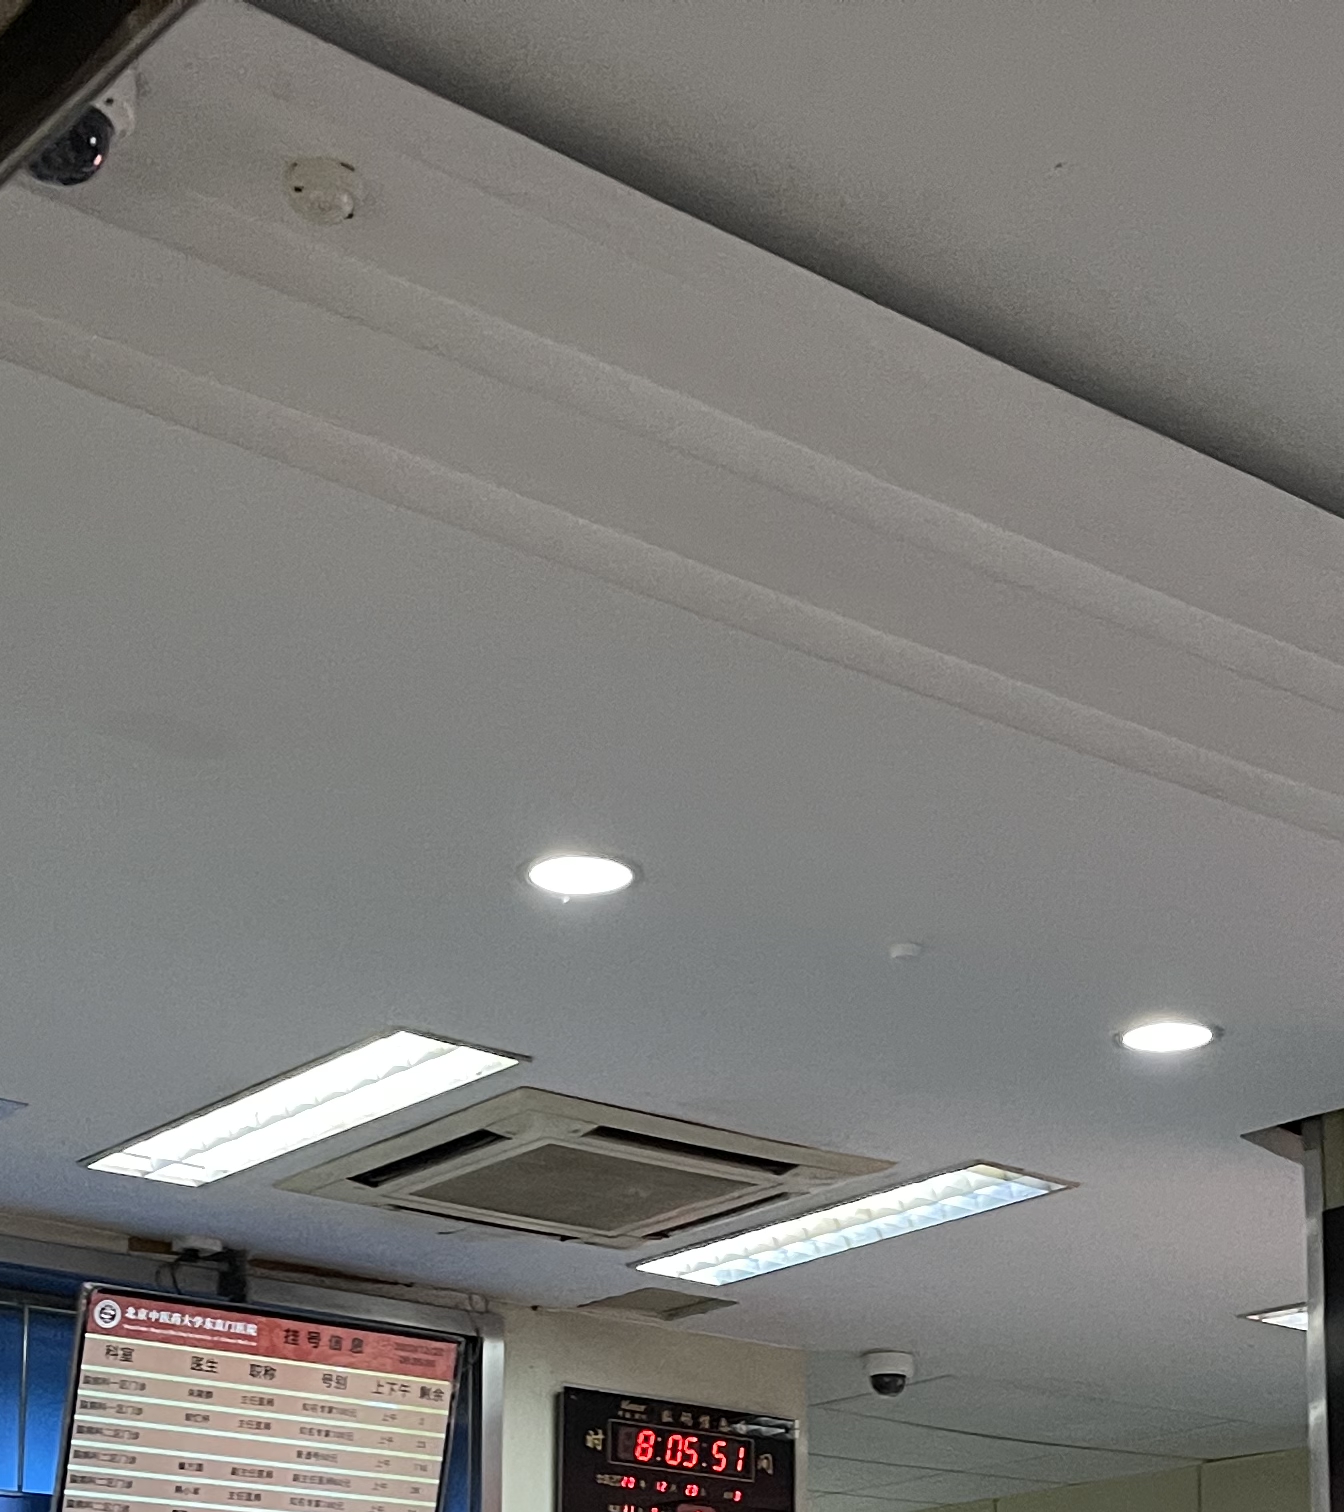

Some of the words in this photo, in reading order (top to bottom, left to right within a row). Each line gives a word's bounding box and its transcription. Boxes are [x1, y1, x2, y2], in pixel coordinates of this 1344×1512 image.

[283, 1327, 365, 1354] 挂号信息
[191, 1355, 219, 1374] 医生
[321, 1373, 348, 1391] 号别
[371, 1379, 412, 1399] 上下午
[634, 1428, 746, 1472] 8:05:51
